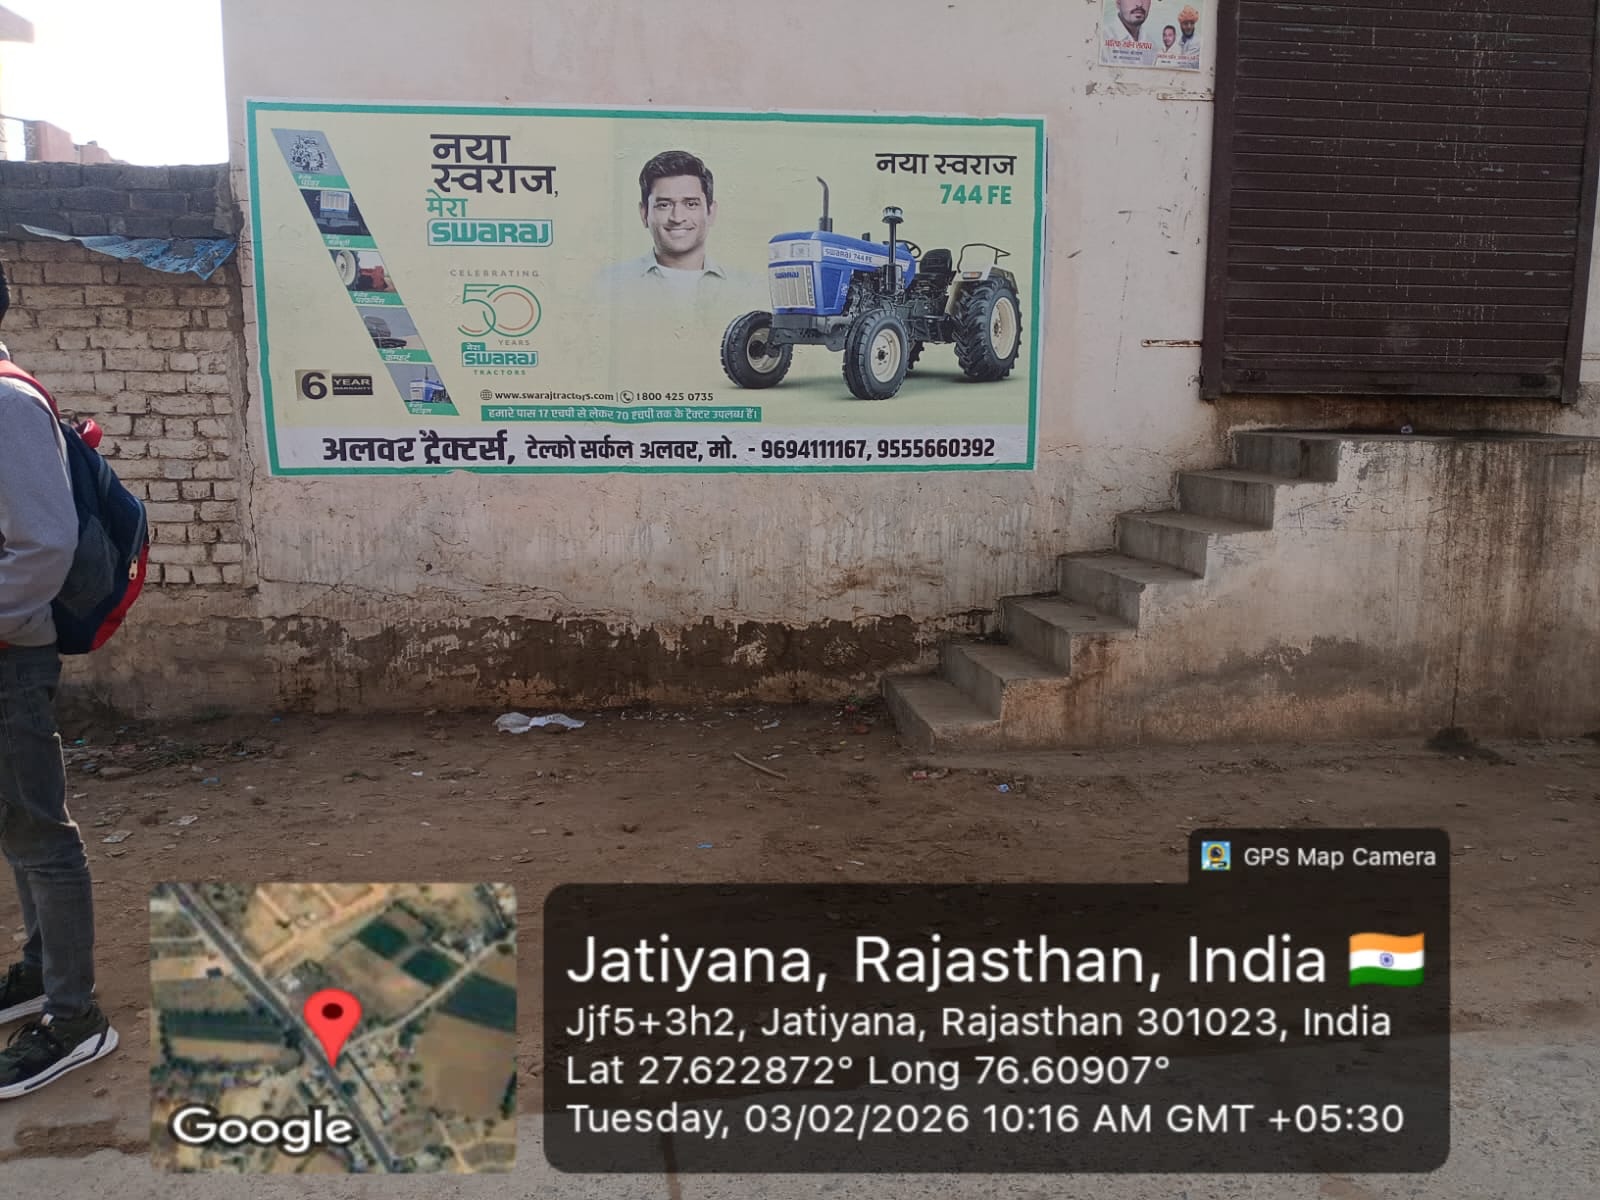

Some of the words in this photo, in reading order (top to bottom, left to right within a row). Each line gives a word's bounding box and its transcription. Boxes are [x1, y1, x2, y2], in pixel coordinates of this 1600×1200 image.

[430, 134, 511, 164] नया
[875, 153, 929, 174] नया
[934, 154, 1017, 175] स्वराज
[431, 164, 558, 198] स्वराज,
[425, 188, 468, 217] मेरा
[940, 184, 983, 205] 744
[987, 185, 1012, 205] FE
[450, 269, 540, 277] CELEBRATING
[457, 283, 542, 338] 50
[301, 372, 328, 400] 6
[333, 378, 371, 386] YEAR
[494, 391, 614, 401] www.swarajtractors.com
[636, 392, 662, 401] 1800
[664, 392, 684, 401] 425
[687, 392, 714, 401] 0735
[488, 406, 515, 418] हमारे
[516, 408, 536, 418] पास
[538, 408, 549, 418] 17
[551, 407, 575, 418] एचपी
[577, 406, 588, 418] से
[589, 407, 614, 419] लेकर
[615, 410, 629, 420] 70
[656, 409, 673, 419] तक
[674, 408, 684, 419] के
[712, 409, 744, 419] उपलब्ध
[322, 437, 416, 462] अलवर
[418, 429, 516, 465] ट्रैक्टर्स,
[525, 434, 576, 459] टेल्को
[578, 434, 634, 459] सर्कल
[639, 440, 703, 462] अलवर,
[706, 435, 737, 459] मो.
[761, 439, 873, 461] 9694111167,
[877, 438, 995, 459] 9555660392
